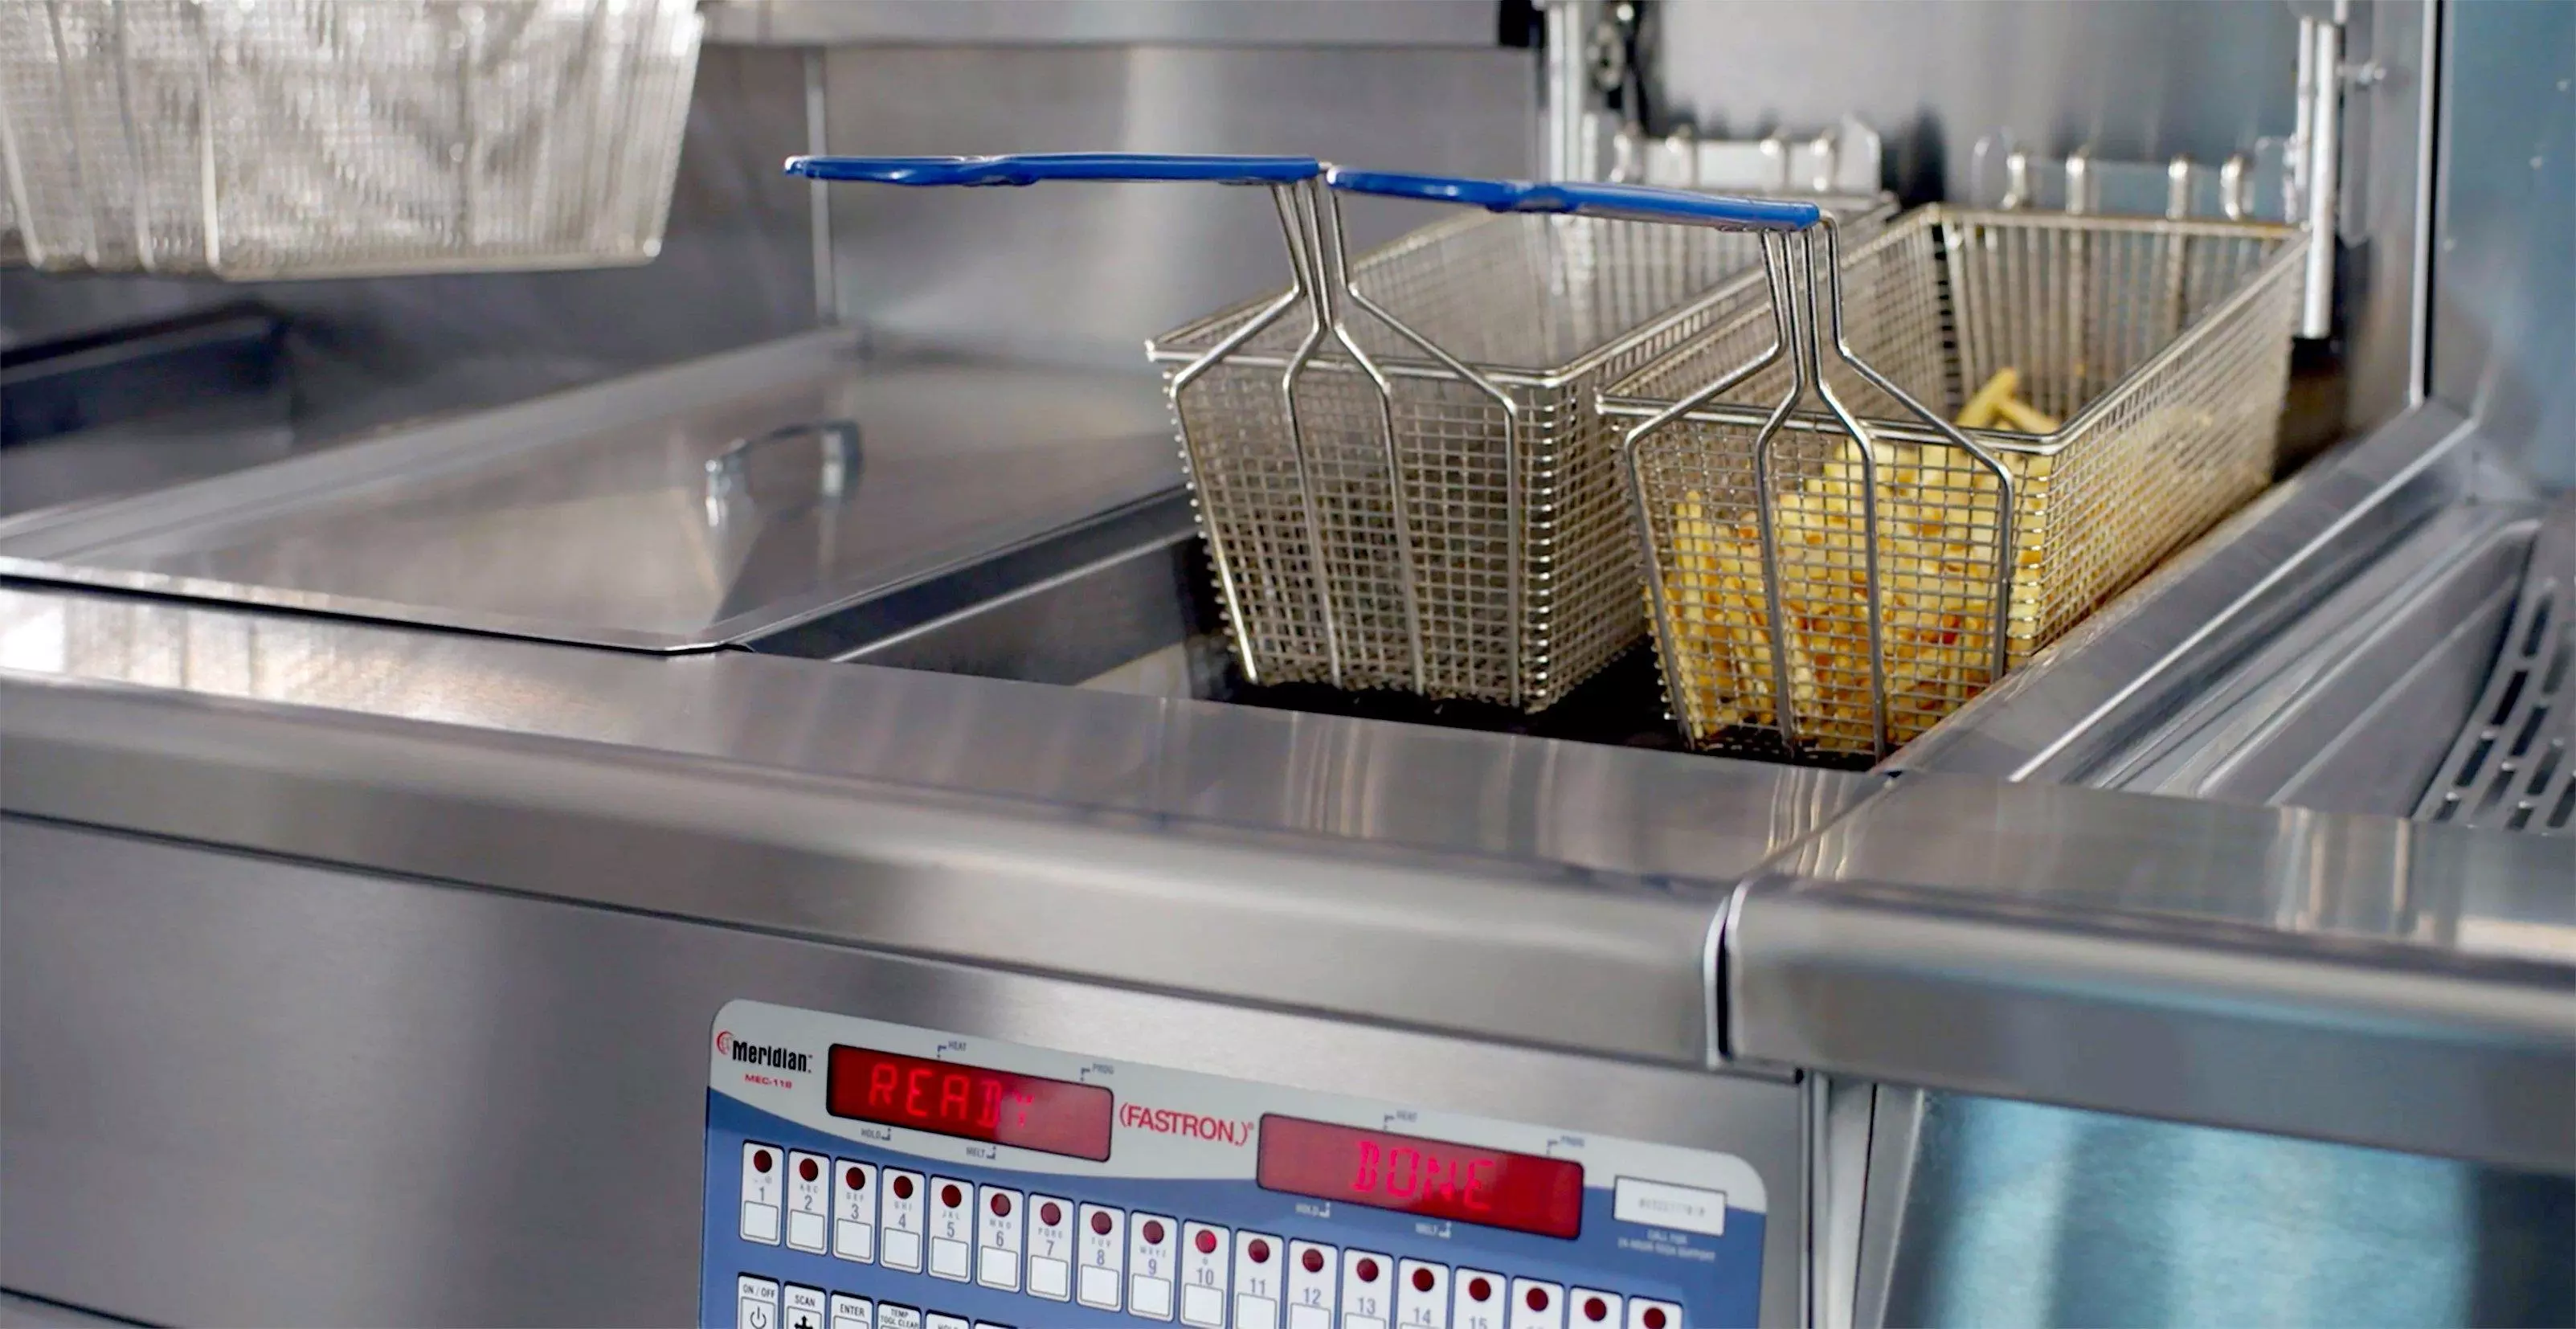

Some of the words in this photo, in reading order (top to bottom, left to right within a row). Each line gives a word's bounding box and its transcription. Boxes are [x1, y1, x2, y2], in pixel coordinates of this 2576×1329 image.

[868, 1062, 1035, 1128] READY
[758, 1186, 765, 1200] 1
[804, 1195, 812, 1210] 2
[851, 1204, 859, 1219] 3
[898, 1213, 906, 1229] 4
[947, 1222, 955, 1237] 5
[996, 1231, 1004, 1246] 6
[1046, 1241, 1054, 1256] 7
[1096, 1249, 1105, 1266] 8
[1147, 1258, 1156, 1275] 9
[1196, 1268, 1214, 1286] 10
[742, 1284, 754, 1294] ON
[762, 1288, 775, 1298] OFF
[1249, 1278, 1266, 1295] 11
[795, 1294, 816, 1307] SCAN
[1303, 1288, 1322, 1306] 12
[840, 1303, 865, 1316] ENTER
[891, 1308, 909, 1318] TEMP
[1357, 1298, 1376, 1315] 13
[1413, 1307, 1431, 1324] 14
